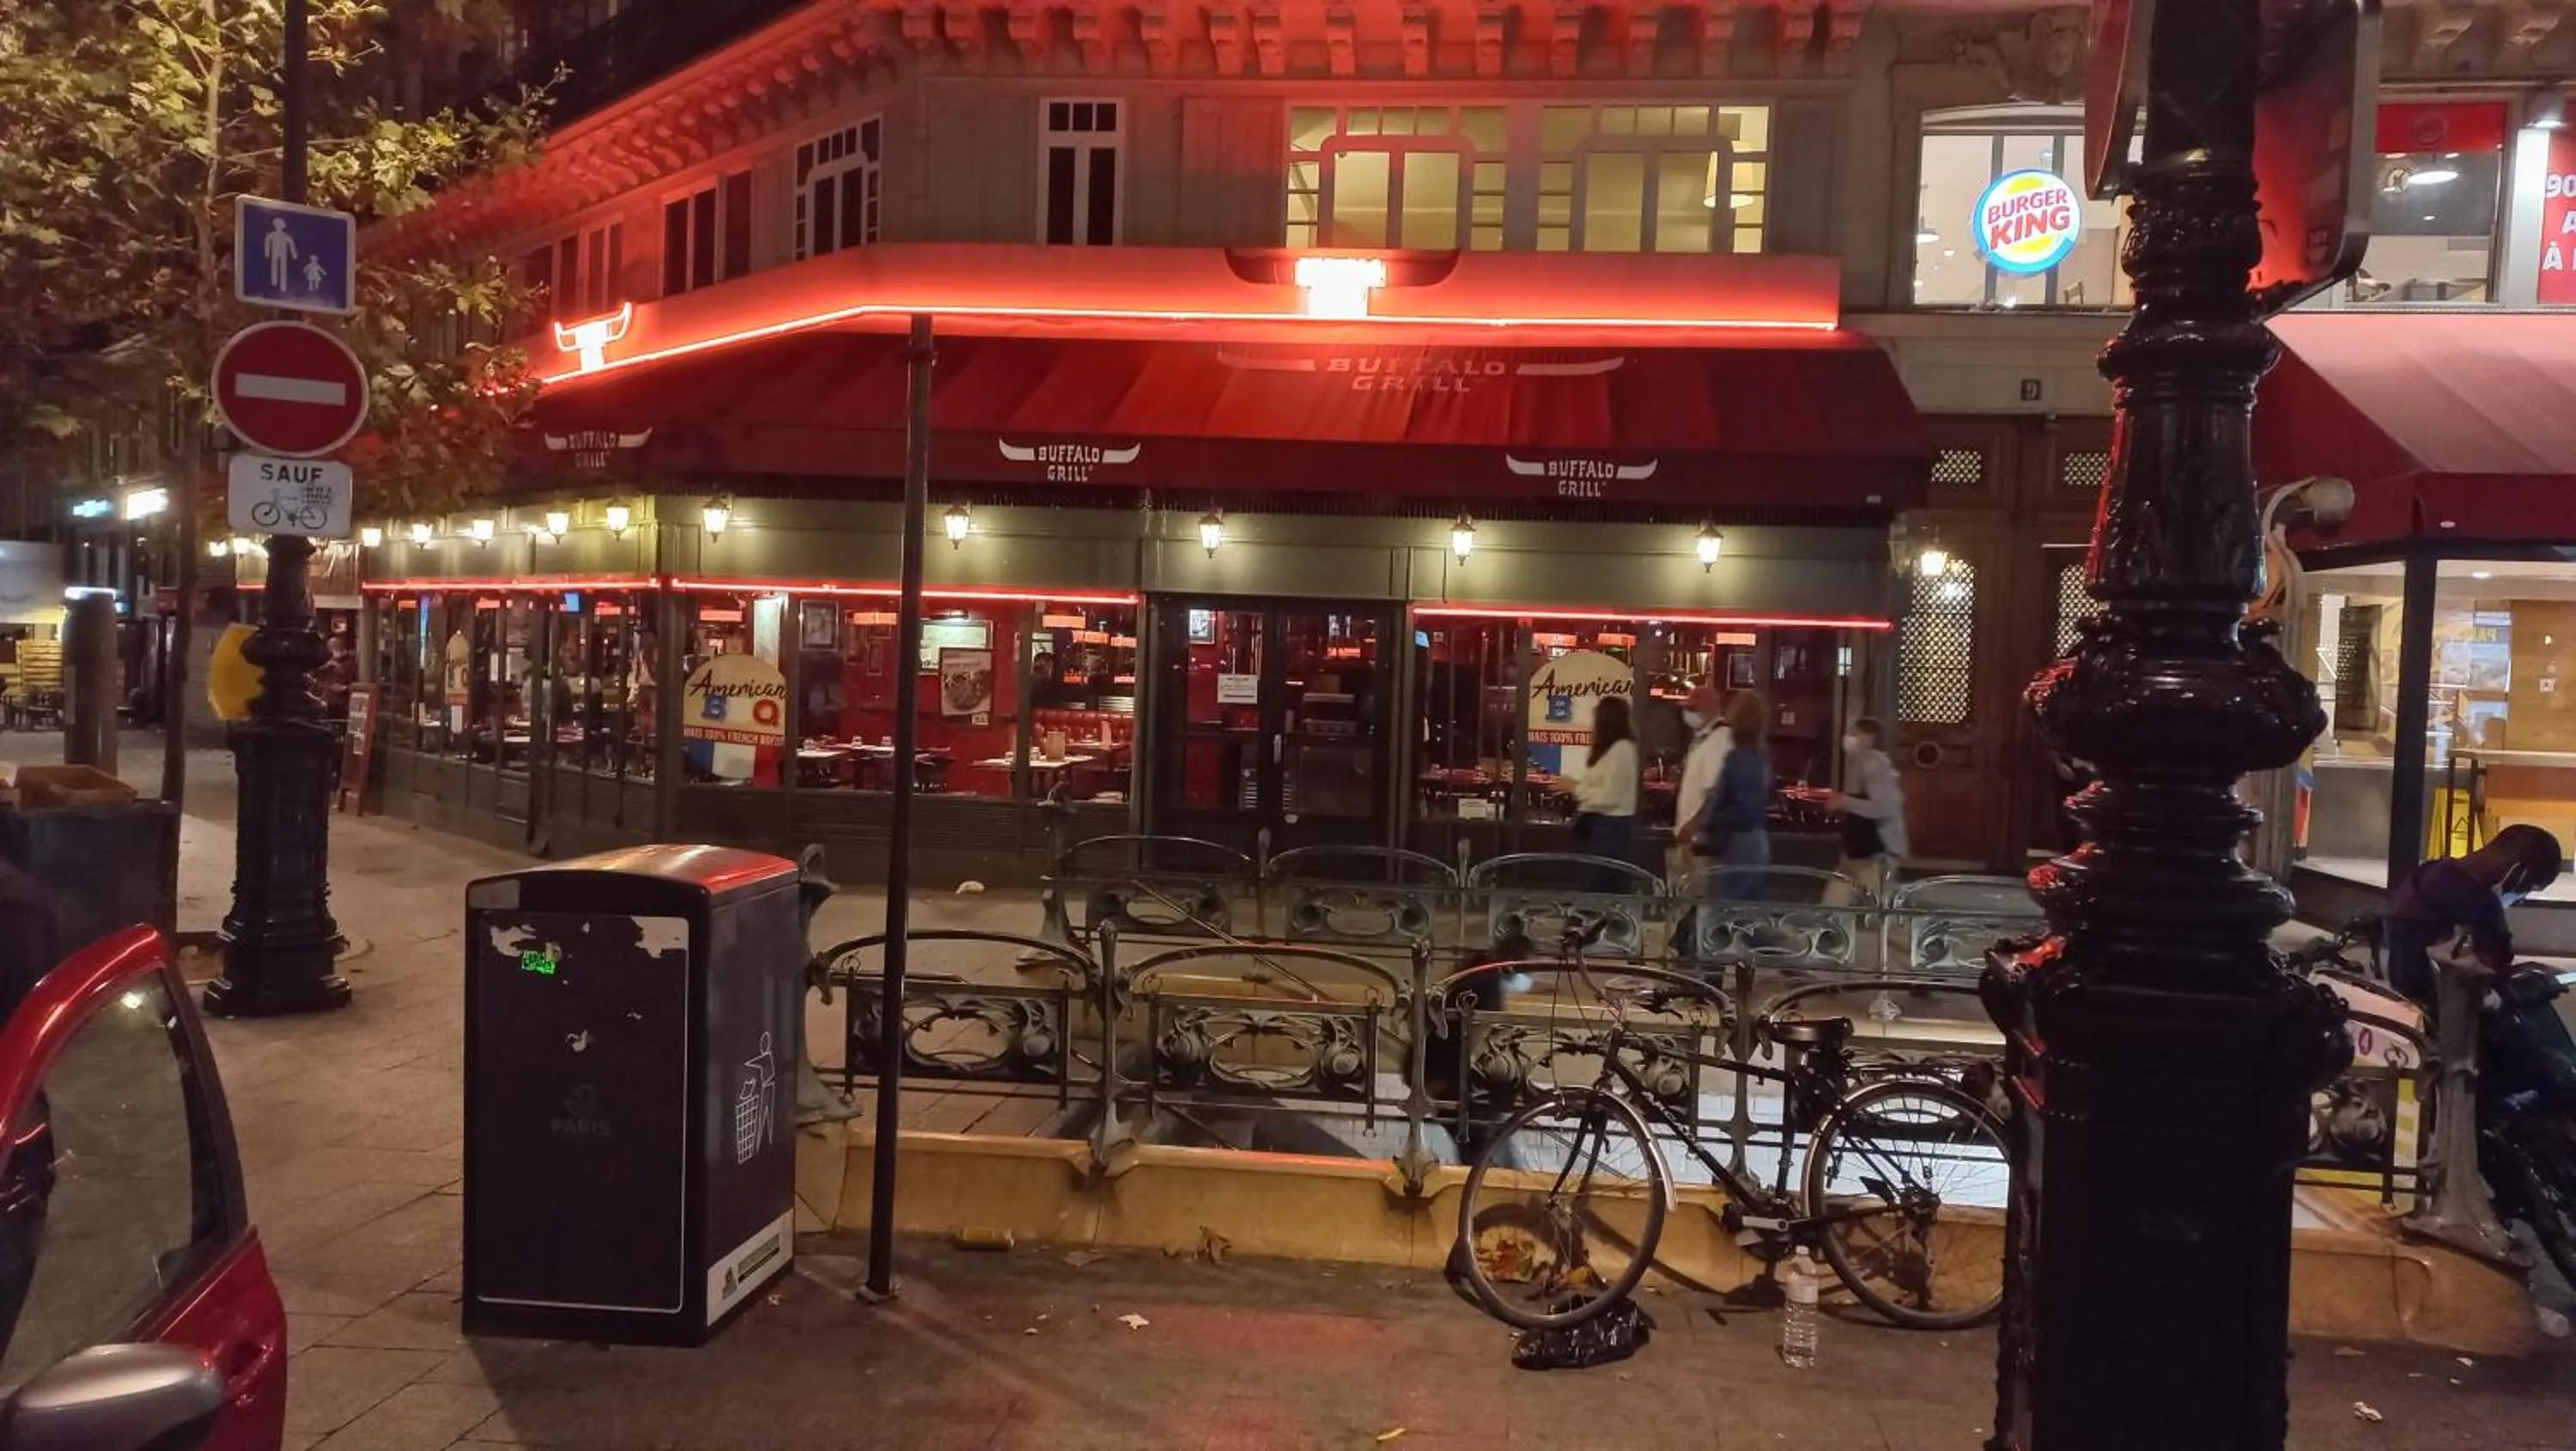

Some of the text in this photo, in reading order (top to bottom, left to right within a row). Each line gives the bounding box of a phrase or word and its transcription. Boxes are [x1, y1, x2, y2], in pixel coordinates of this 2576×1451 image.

[1988, 189, 2068, 224] BURGER
[1990, 205, 2070, 250] KING
[1326, 357, 1506, 375] BUFFALO
[1352, 375, 1471, 393] GRILL
[1038, 444, 1100, 463] BUFFALO
[260, 463, 324, 483] SAUF
[1047, 464, 1089, 482] GRILL
[1548, 459, 1614, 478] BUFFALO
[1558, 480, 1601, 497] GRILL
[689, 669, 791, 700] American
[1531, 668, 1634, 701] American
